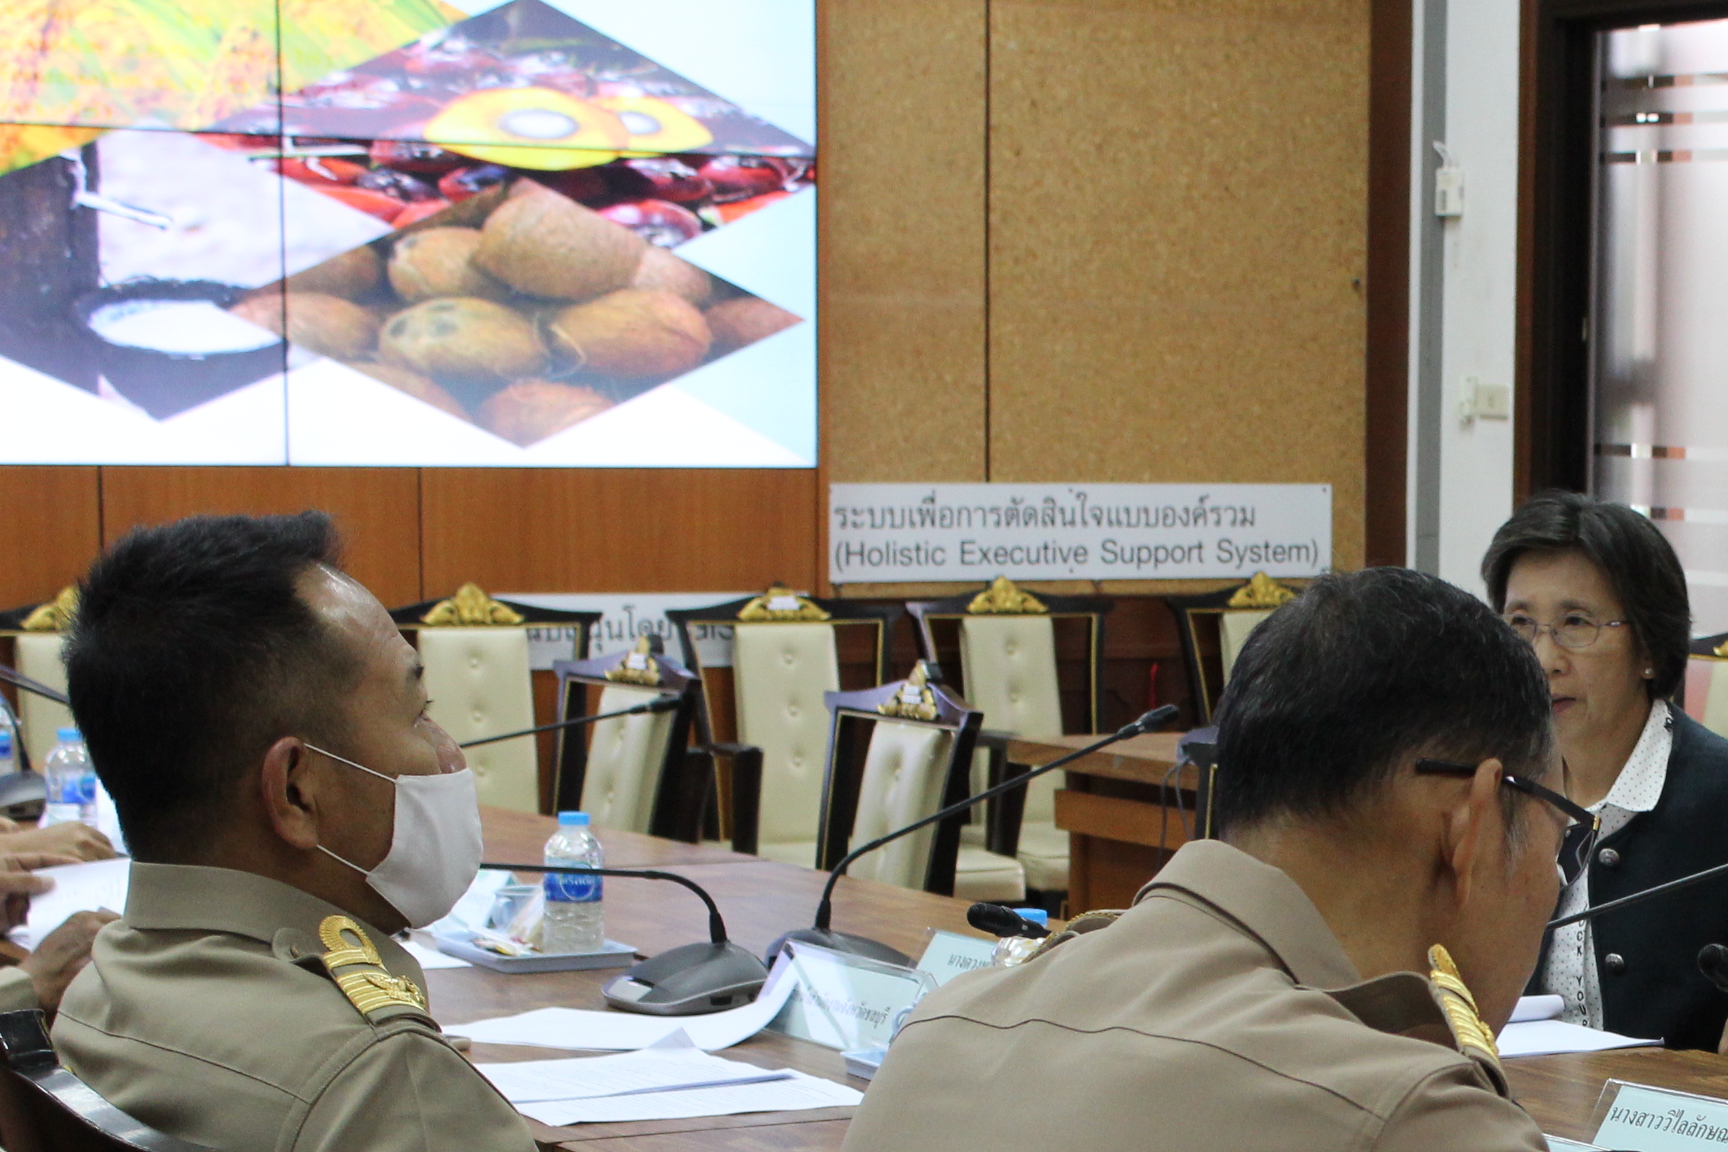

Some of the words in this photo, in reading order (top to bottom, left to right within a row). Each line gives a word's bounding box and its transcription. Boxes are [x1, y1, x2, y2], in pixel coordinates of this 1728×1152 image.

[834, 490, 1256, 529] ระบบเพื่อการตัดสินใจแบบองค์รวม
[835, 540, 946, 574] (Holistic
[960, 541, 1087, 566] Executive
[1101, 538, 1204, 569] Support
[1216, 538, 1319, 569] System)
